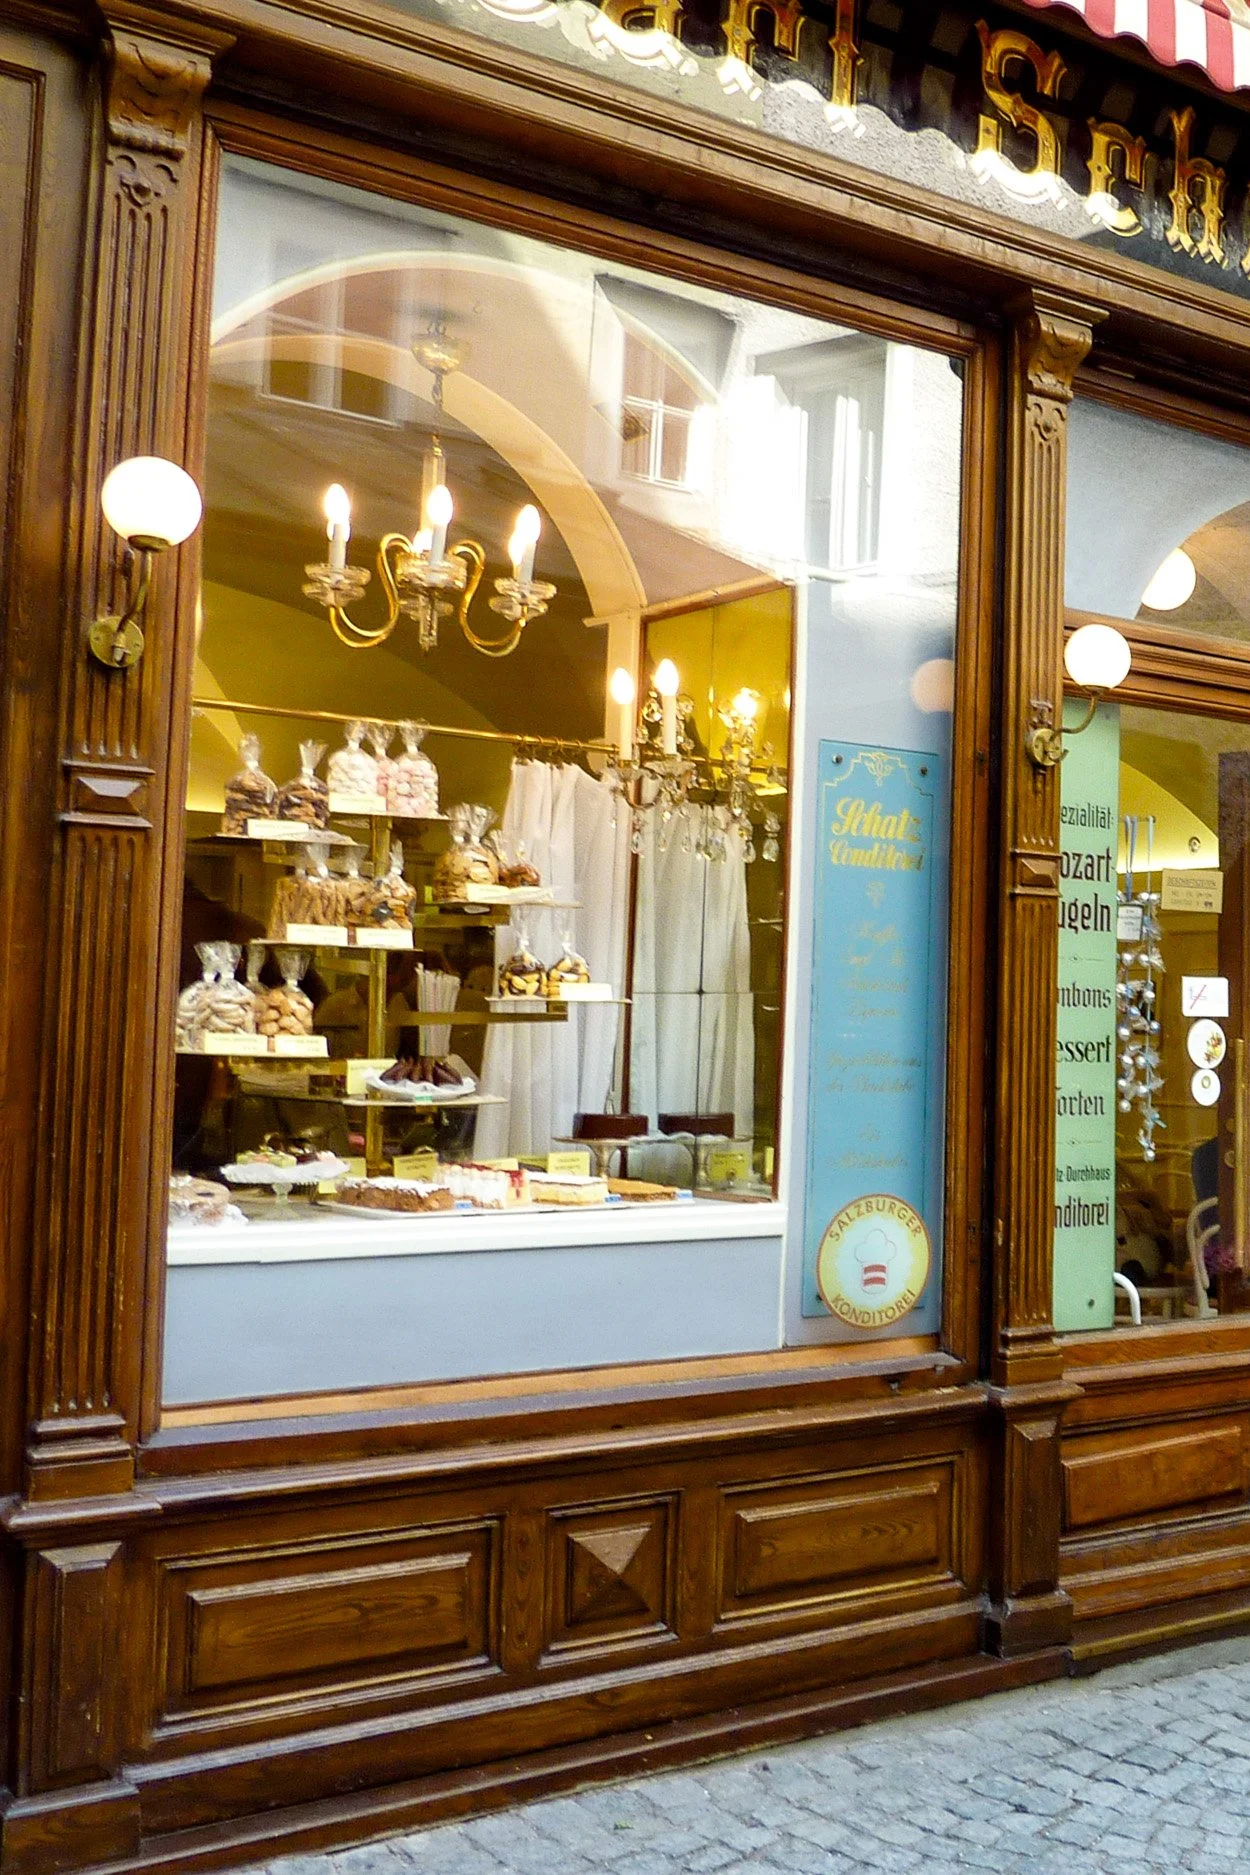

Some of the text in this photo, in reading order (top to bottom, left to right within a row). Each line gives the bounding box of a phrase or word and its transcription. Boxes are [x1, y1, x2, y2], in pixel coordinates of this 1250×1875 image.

[475, 0, 867, 138] arl
[831, 797, 921, 843] Schatz
[1061, 802, 1114, 830] ezialität:
[1060, 847, 1116, 883] ozart-
[1058, 893, 1112, 935] ugeln
[1057, 981, 1112, 1009] nbons
[1056, 1035, 1112, 1063] essert
[1056, 1087, 1105, 1116] orten
[829, 1199, 921, 1242] SALZBURGER
[1055, 1195, 1110, 1228] nditorei
[831, 1288, 916, 1325] KONDITOREI
